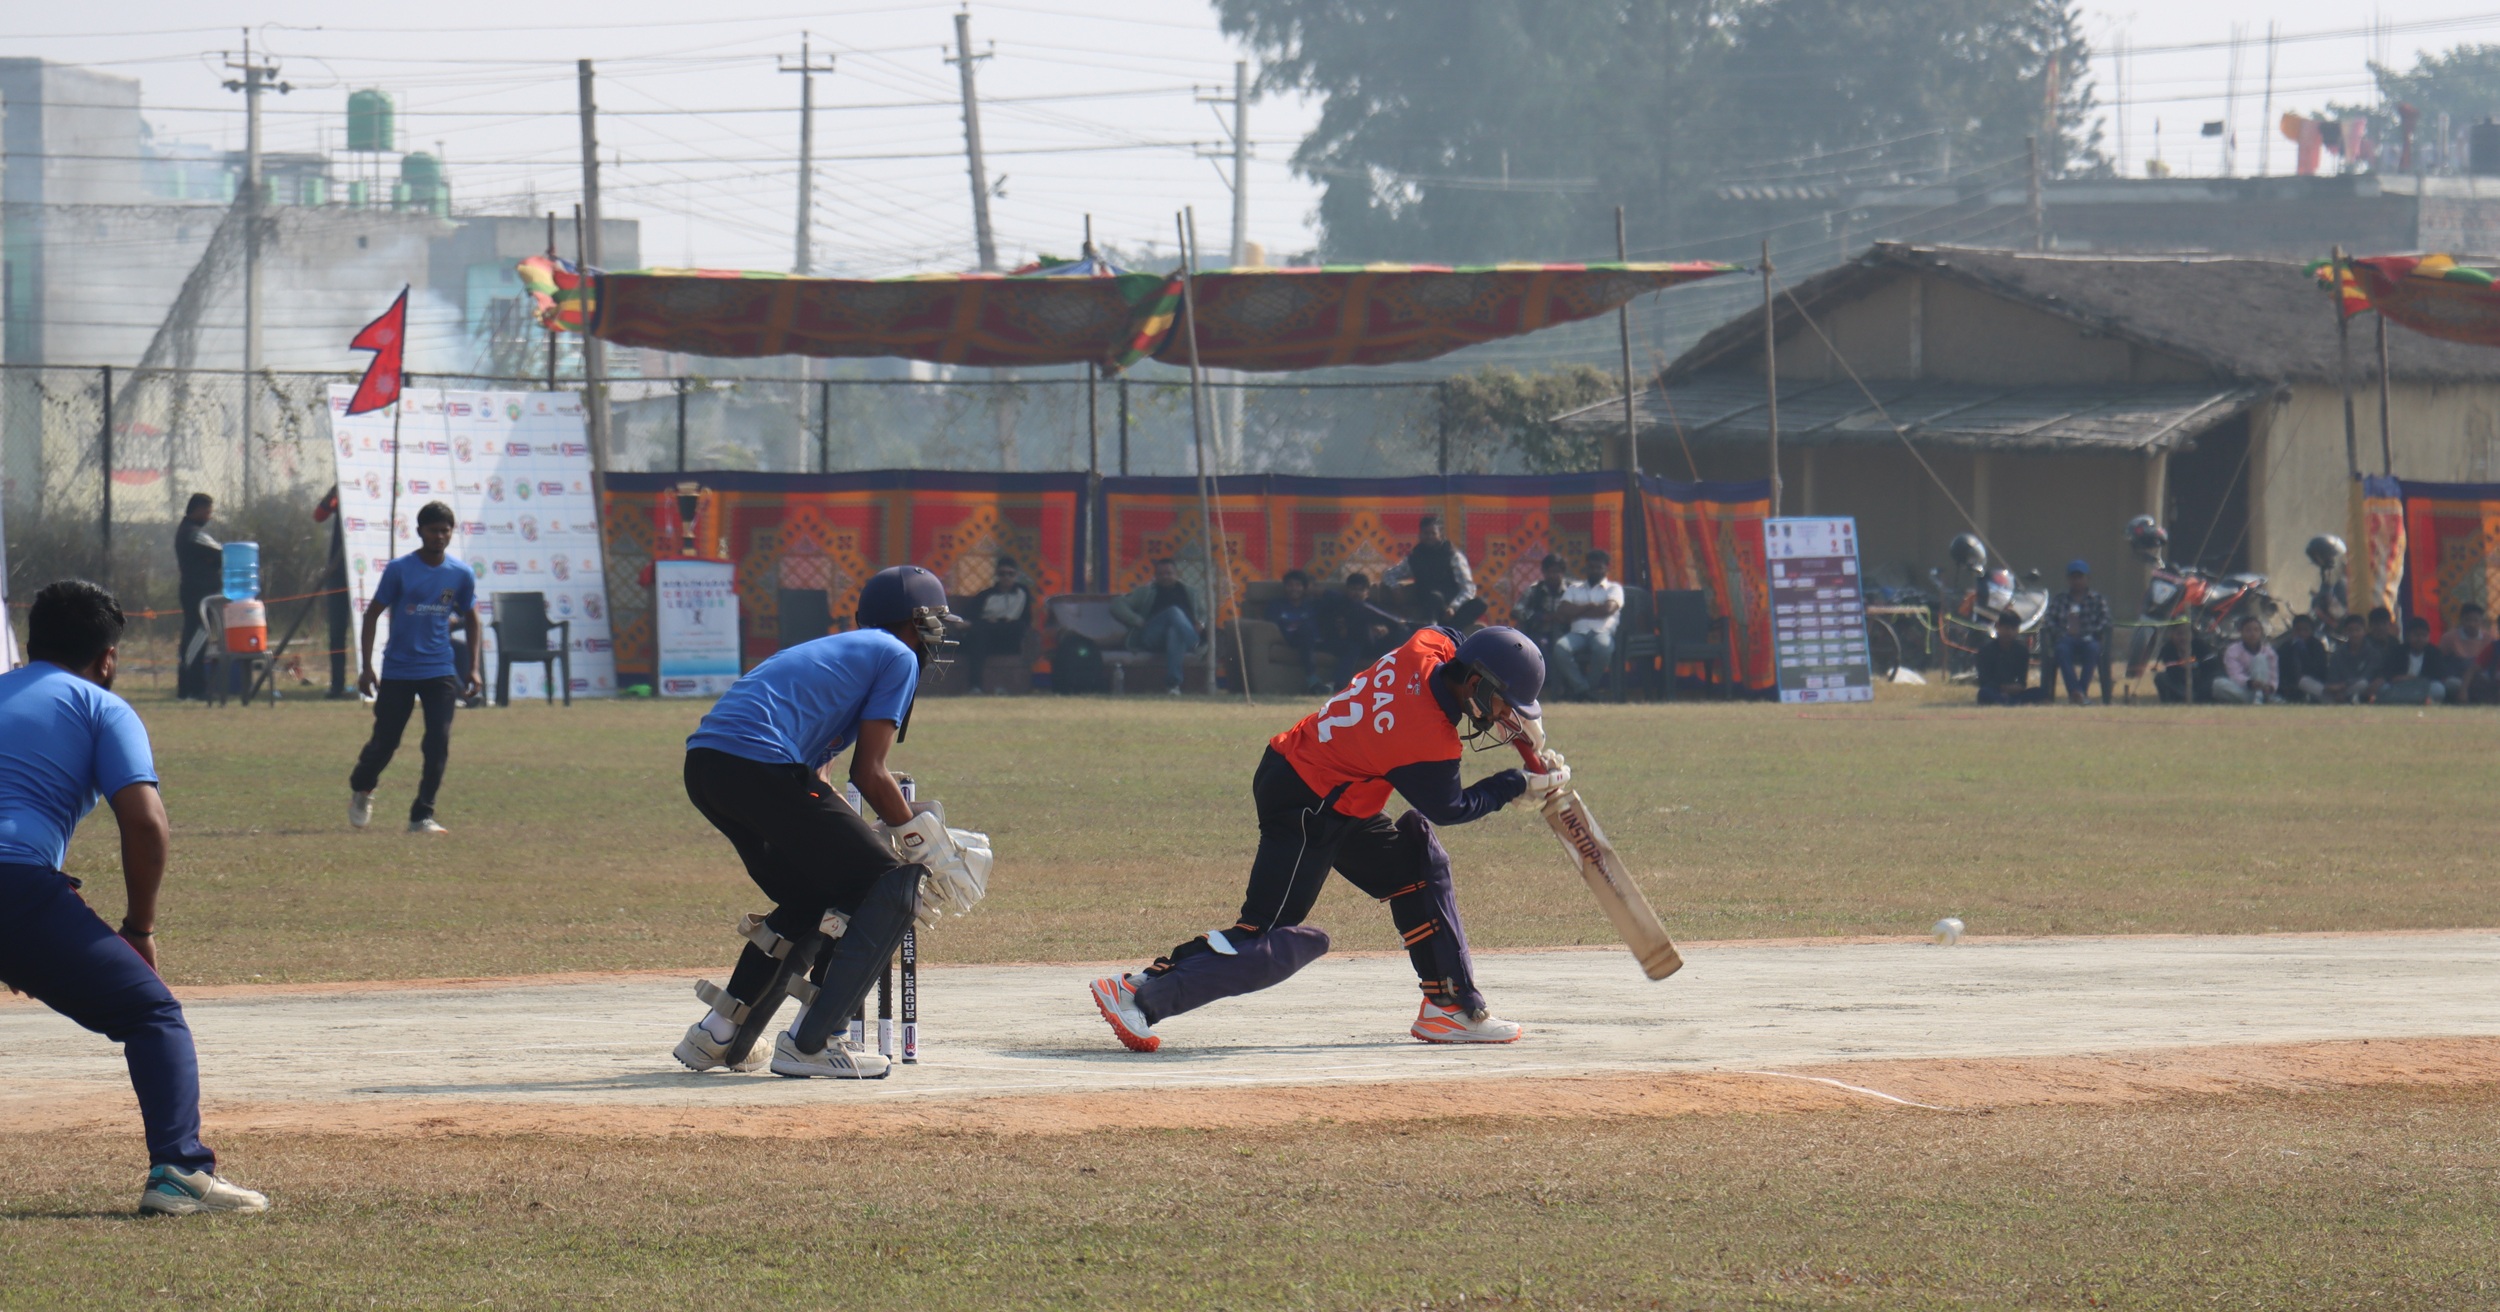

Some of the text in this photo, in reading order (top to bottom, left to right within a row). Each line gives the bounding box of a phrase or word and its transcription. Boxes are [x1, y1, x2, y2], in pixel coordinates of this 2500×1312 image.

[1372, 650, 1398, 734] KCAC
[1560, 808, 1623, 897] UNSTOPPA
[903, 929, 915, 963] CKET
[904, 972, 915, 1019] LEAGUE
